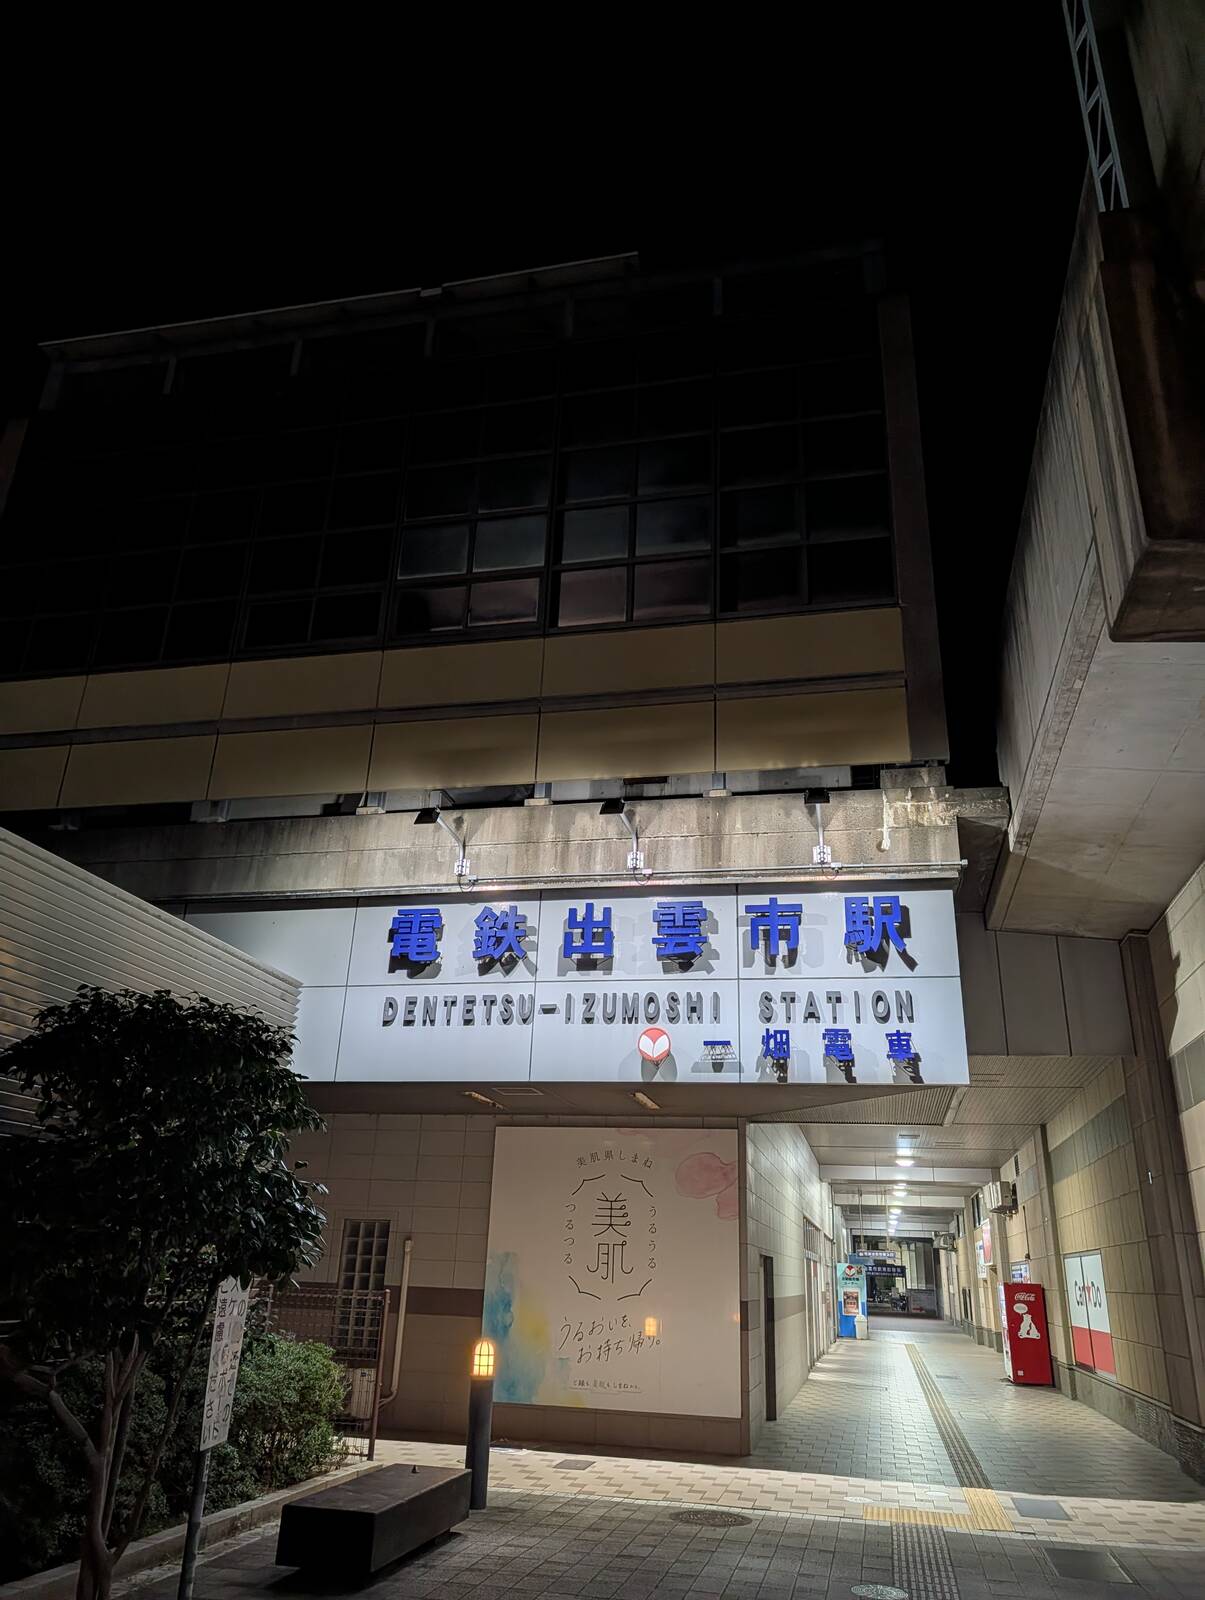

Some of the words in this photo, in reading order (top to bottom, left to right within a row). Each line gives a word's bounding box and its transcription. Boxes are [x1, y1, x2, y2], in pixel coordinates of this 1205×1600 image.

[391, 896, 907, 962] 電鉄出雲市駅
[382, 992, 720, 1027] DENTETSU-IZUMOSHI
[758, 990, 914, 1024] STATION
[576, 1150, 653, 1168] 美肌県しまね
[562, 1202, 577, 1265] つるつる
[586, 1192, 634, 1284] 美肌
[647, 1206, 657, 1270] うるうる
